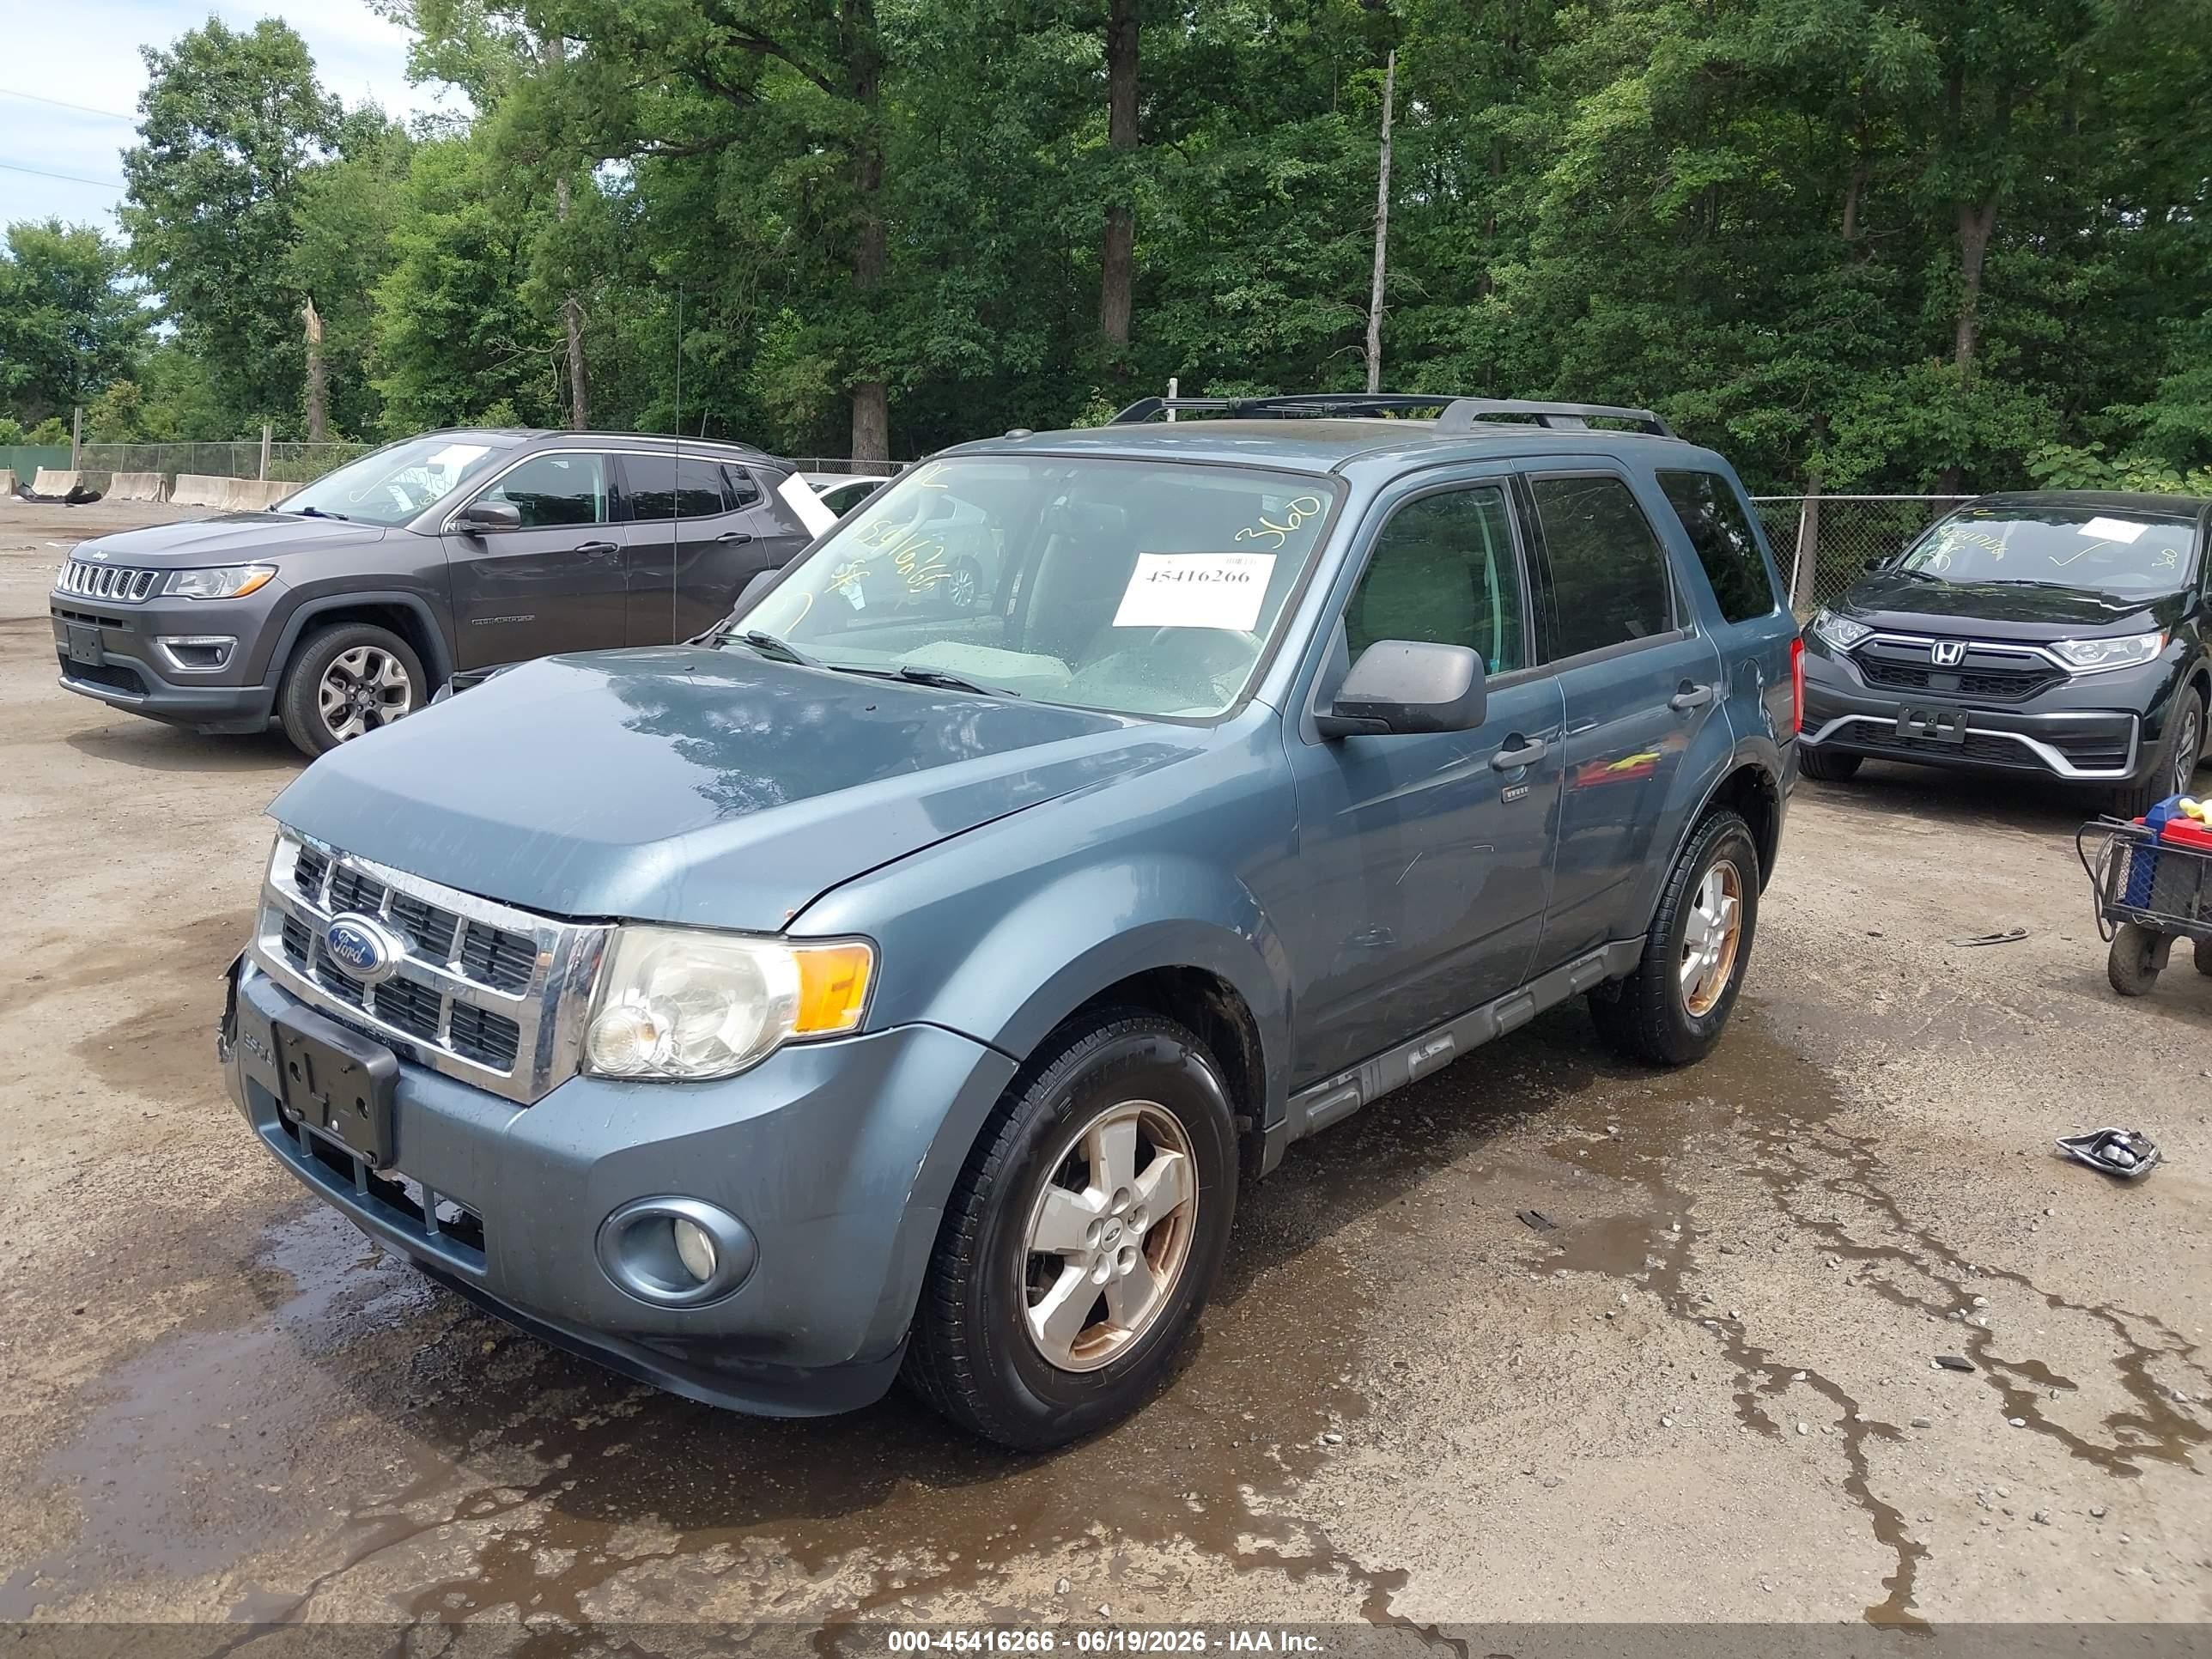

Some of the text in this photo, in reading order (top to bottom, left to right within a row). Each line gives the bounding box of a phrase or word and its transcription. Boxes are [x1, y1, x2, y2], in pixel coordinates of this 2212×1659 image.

[1234, 496, 1321, 550] 360
[2150, 548, 2179, 569] 360
[1146, 569, 1251, 584] 45416266
[333, 929, 366, 963] Ford
